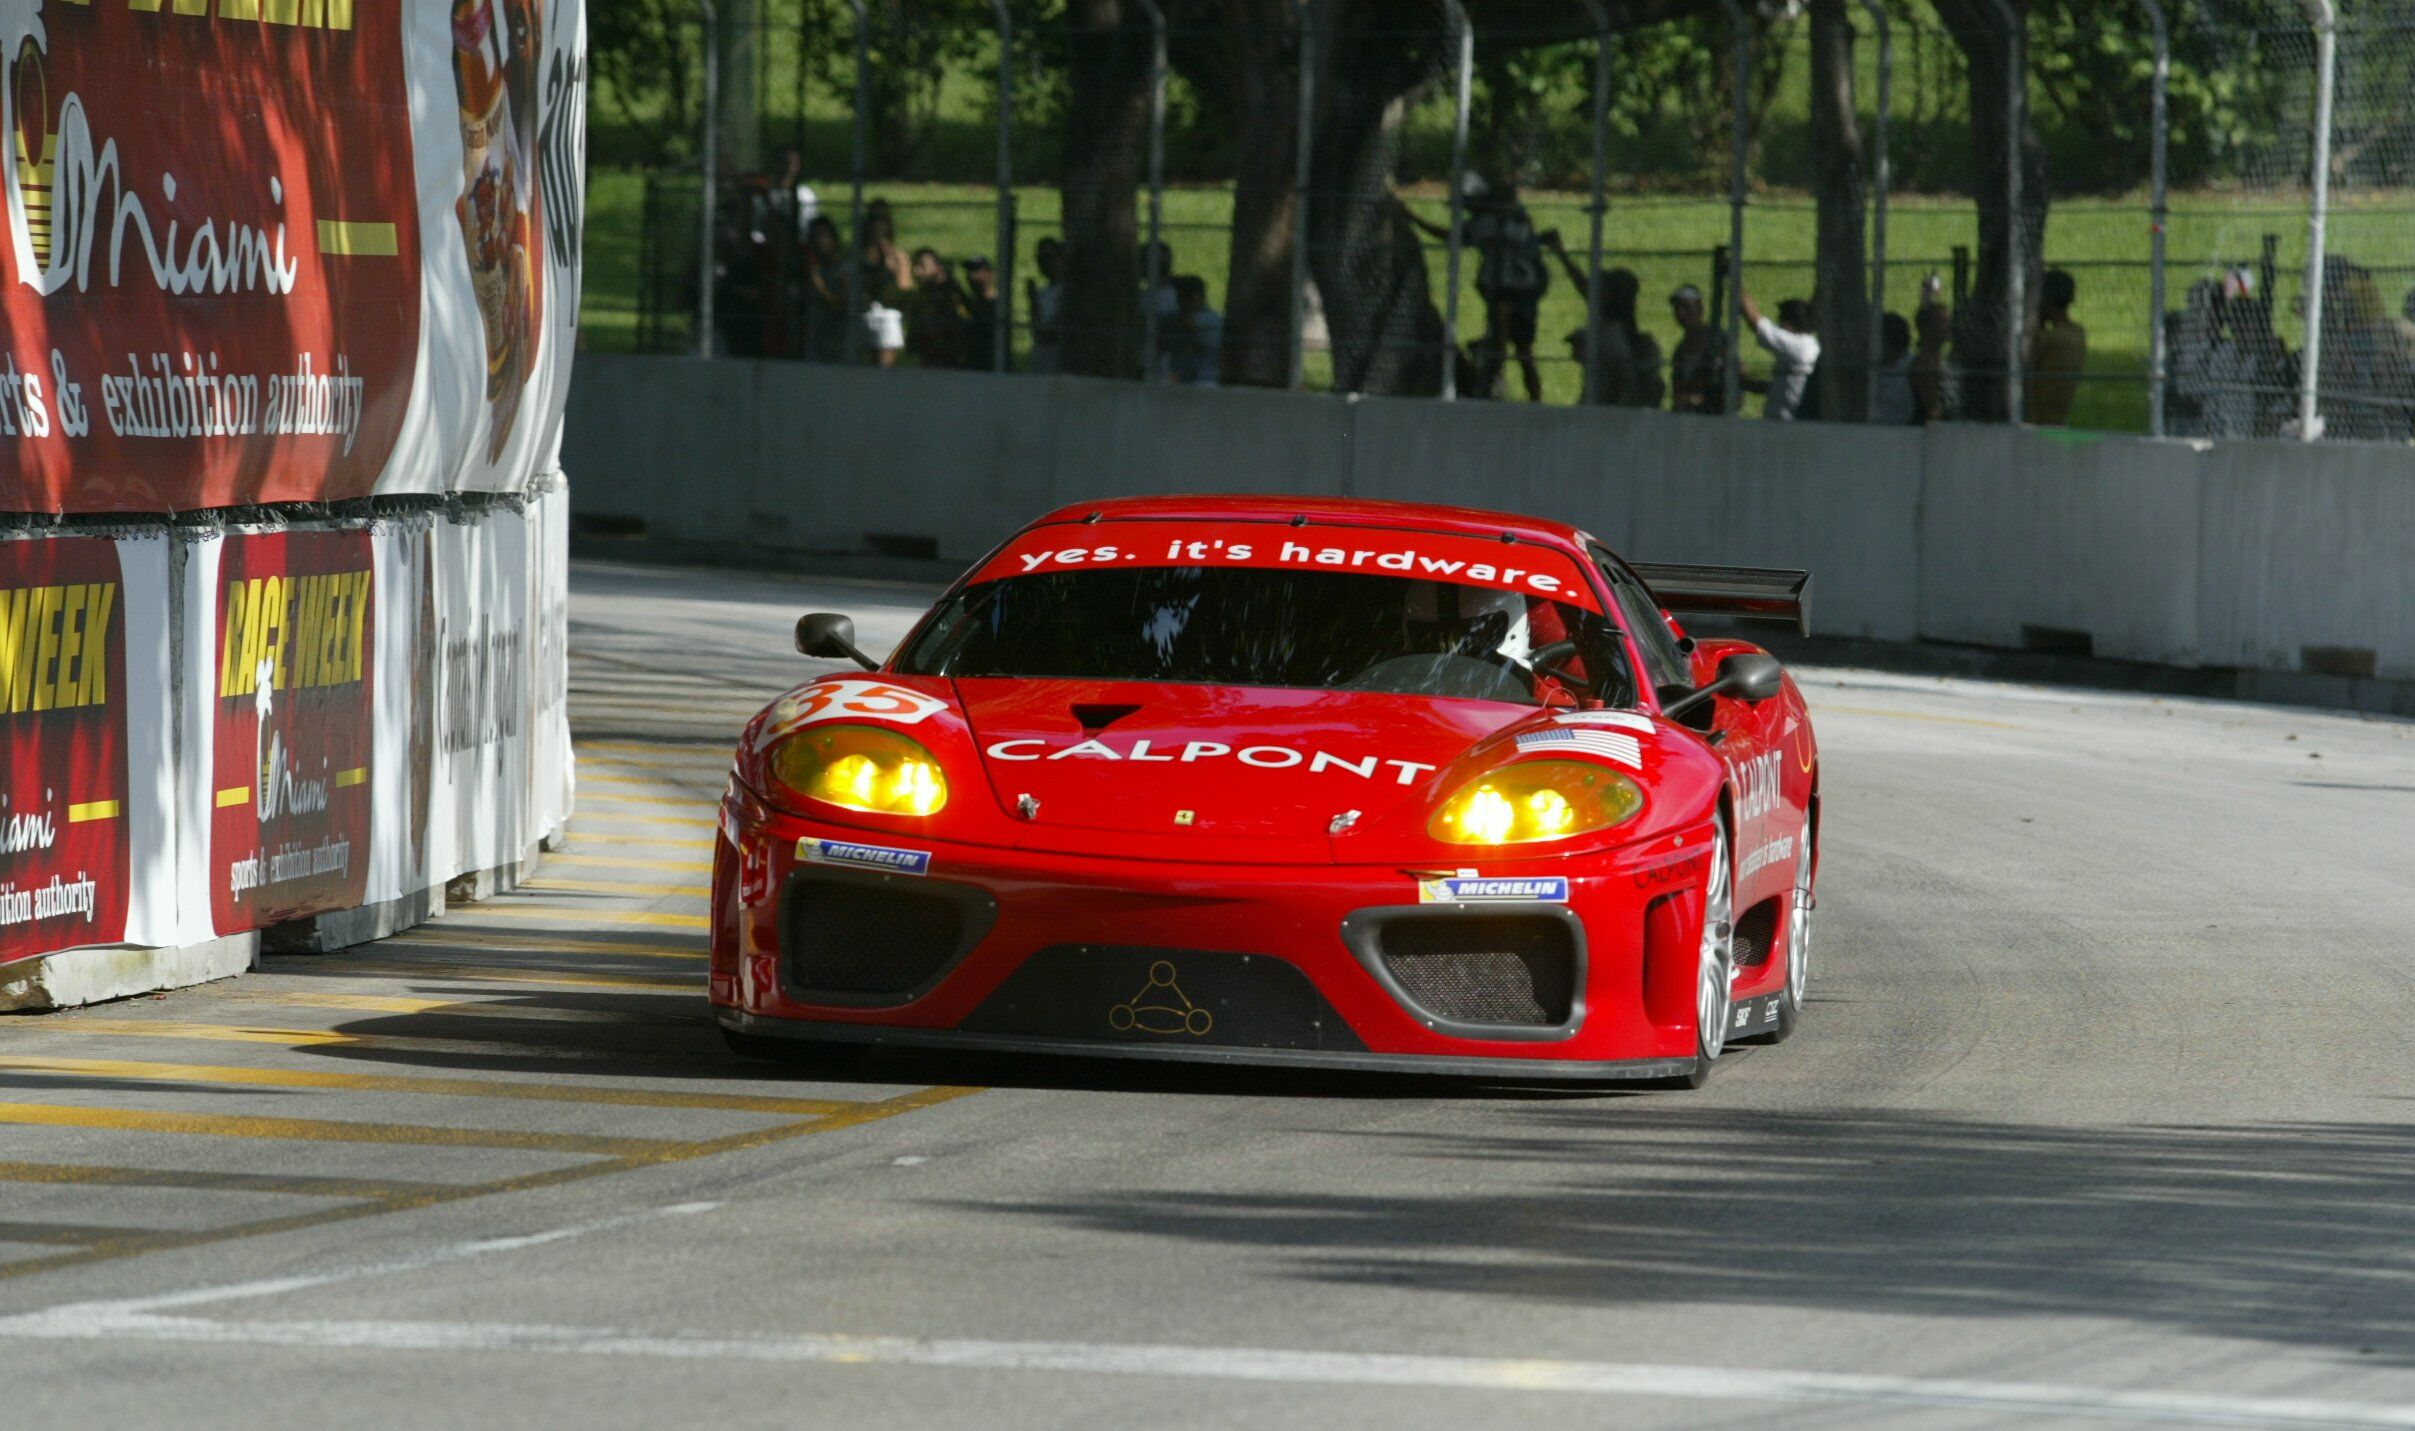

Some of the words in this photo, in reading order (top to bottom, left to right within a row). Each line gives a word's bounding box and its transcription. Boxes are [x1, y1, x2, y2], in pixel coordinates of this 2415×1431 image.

[45, 90, 297, 296] Miami
[52, 348, 89, 437] &
[101, 351, 258, 438] exhibition
[263, 351, 363, 457] authority
[1020, 546, 1136, 571] yes.
[1167, 539, 1252, 560] it's
[1279, 541, 1577, 598] hardware.
[0, 583, 115, 714] WEEK
[220, 575, 297, 698] RACE
[292, 570, 371, 689] WEEK
[767, 684, 932, 735] 35
[262, 729, 328, 823] Miami
[987, 739, 1437, 786] CALPONT
[230, 849, 258, 903] sports
[270, 841, 312, 884] exhibition
[312, 831, 350, 880] authority
[827, 844, 920, 867] MICHELIN
[34, 870, 96, 923] authority
[1456, 881, 1558, 896] MICHELIN
